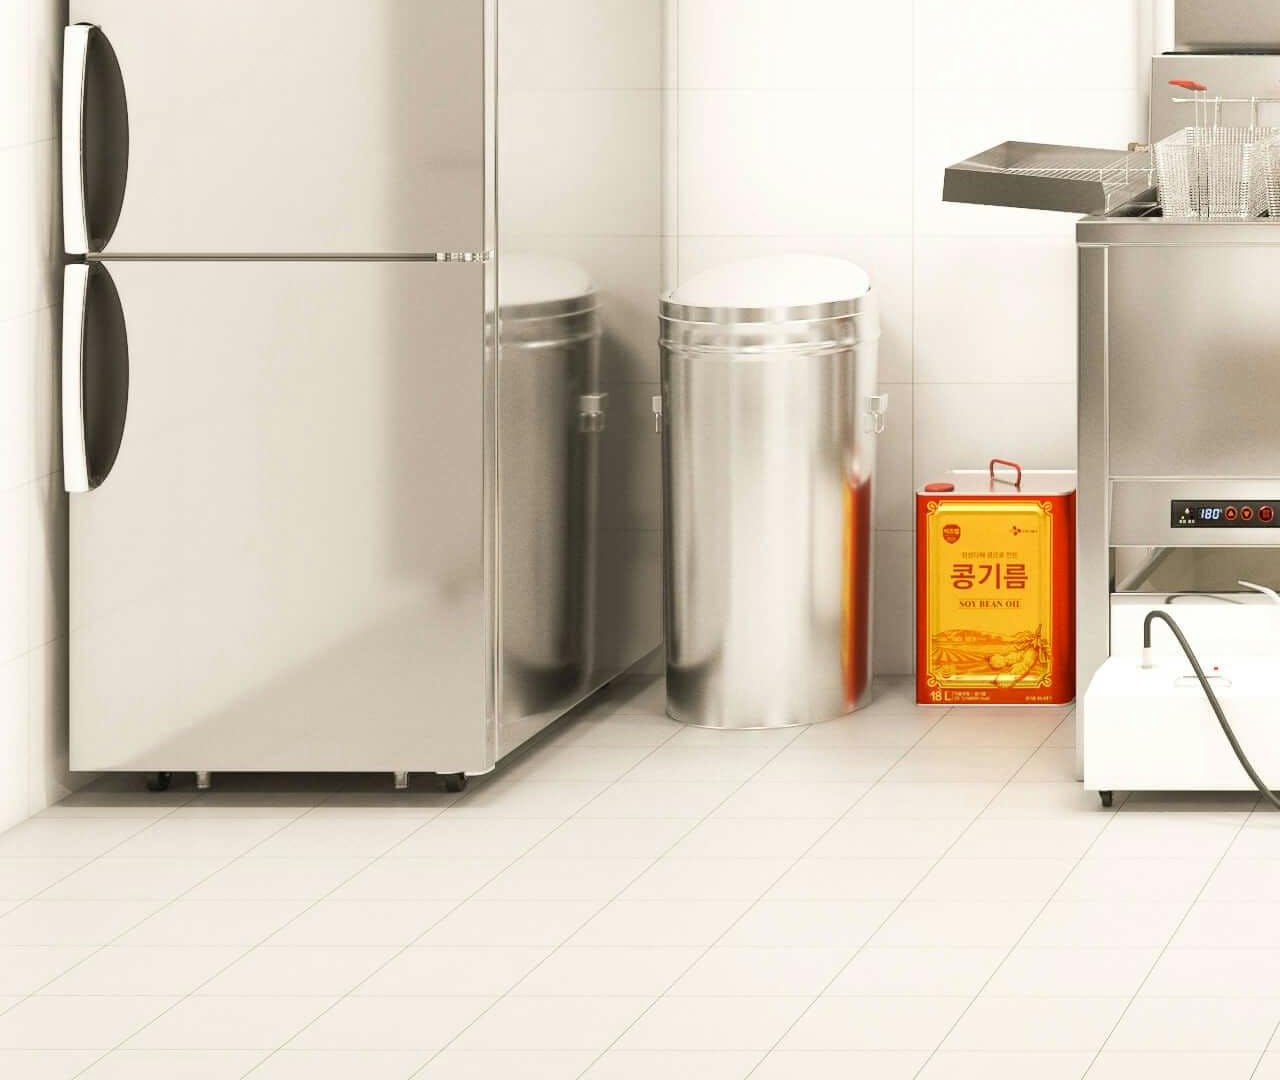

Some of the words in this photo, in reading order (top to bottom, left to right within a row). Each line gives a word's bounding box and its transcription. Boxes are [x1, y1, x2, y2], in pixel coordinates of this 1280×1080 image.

[950, 563, 1028, 590] 콩기름
[959, 600, 976, 608] SOY
[979, 600, 1003, 608] BEAN
